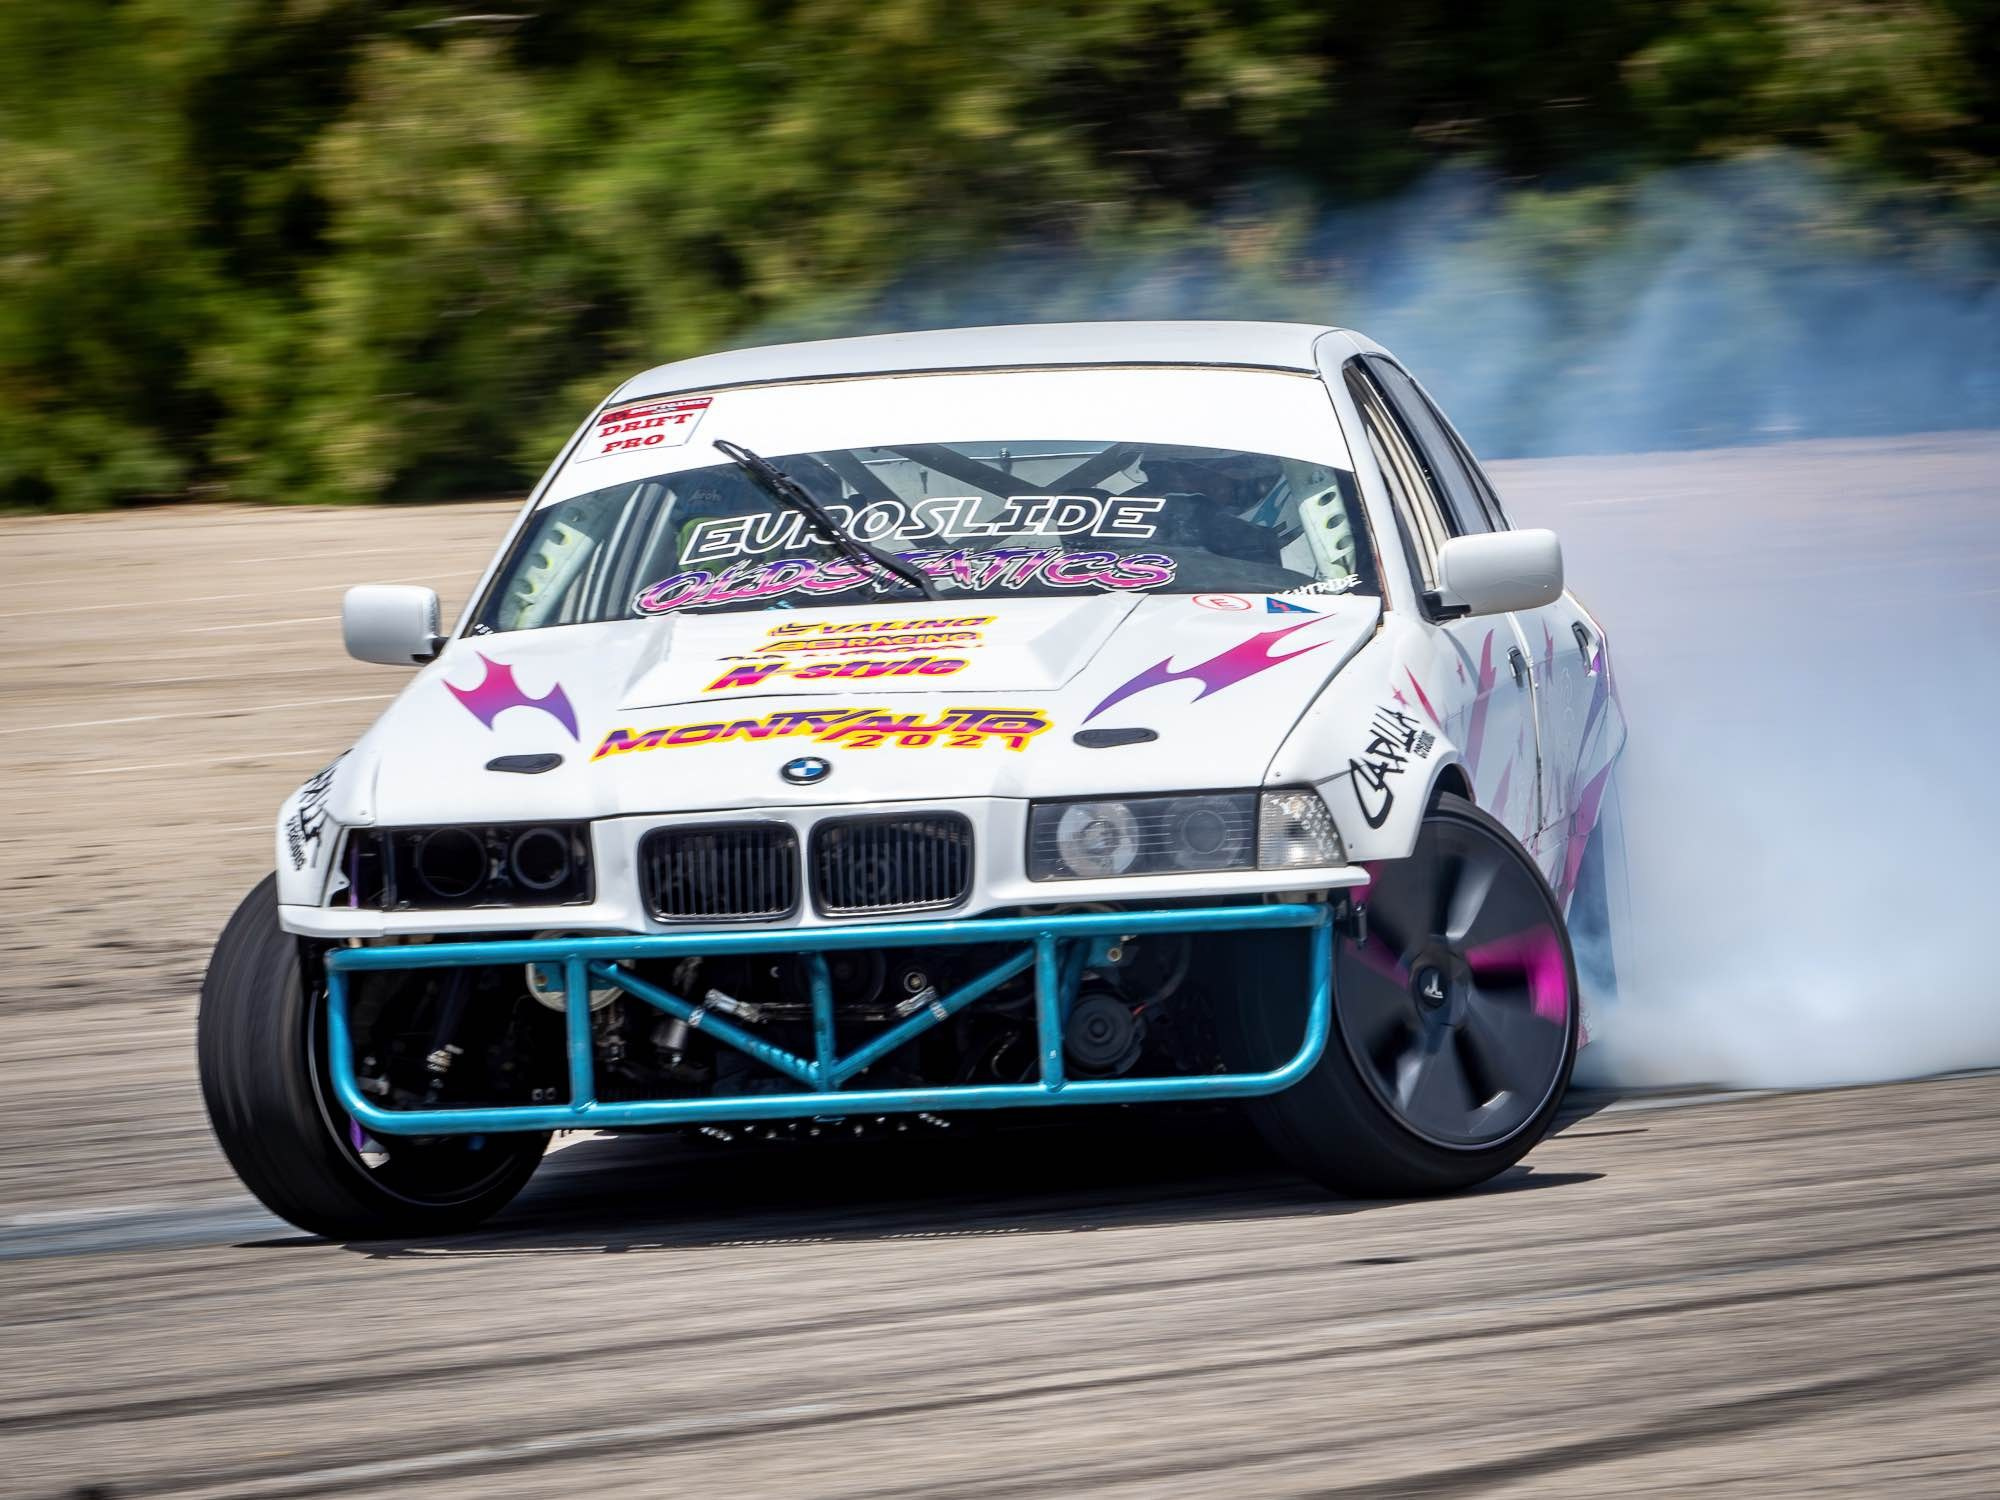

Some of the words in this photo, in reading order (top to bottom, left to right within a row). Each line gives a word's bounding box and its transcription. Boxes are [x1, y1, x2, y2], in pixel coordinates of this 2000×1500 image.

[598, 413, 695, 438] DRIFT
[601, 434, 665, 454] PRO
[679, 495, 1166, 566] EUROSLIDE
[822, 616, 995, 634] VALINO
[840, 732, 1032, 752] 2021
